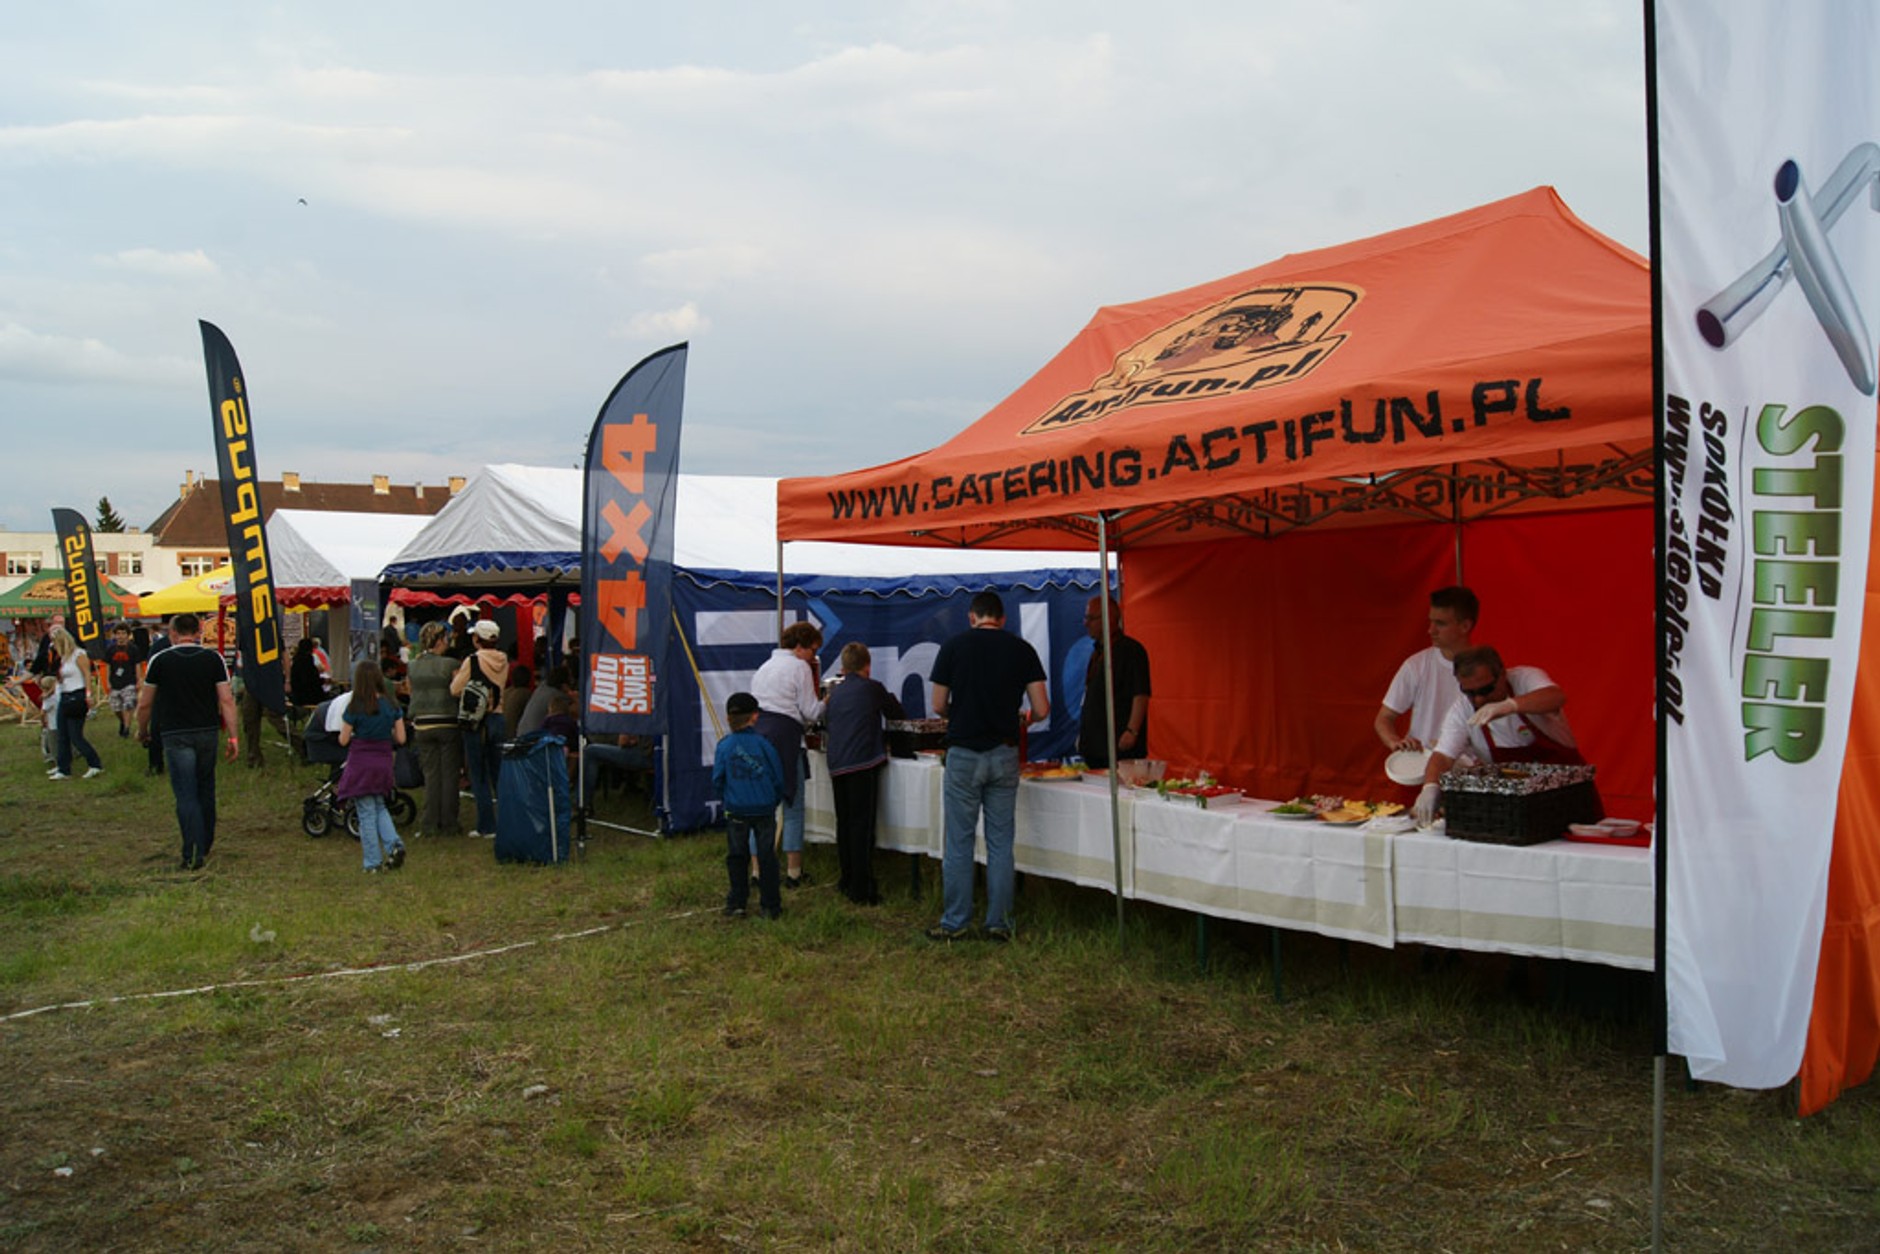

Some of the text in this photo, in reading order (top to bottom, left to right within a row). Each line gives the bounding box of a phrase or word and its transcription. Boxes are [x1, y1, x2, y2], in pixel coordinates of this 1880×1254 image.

[827, 378, 1571, 520] WWW.CATERING.ACTIFUN.PL
[1741, 403, 1846, 765] STEELER
[590, 655, 618, 713] Auto
